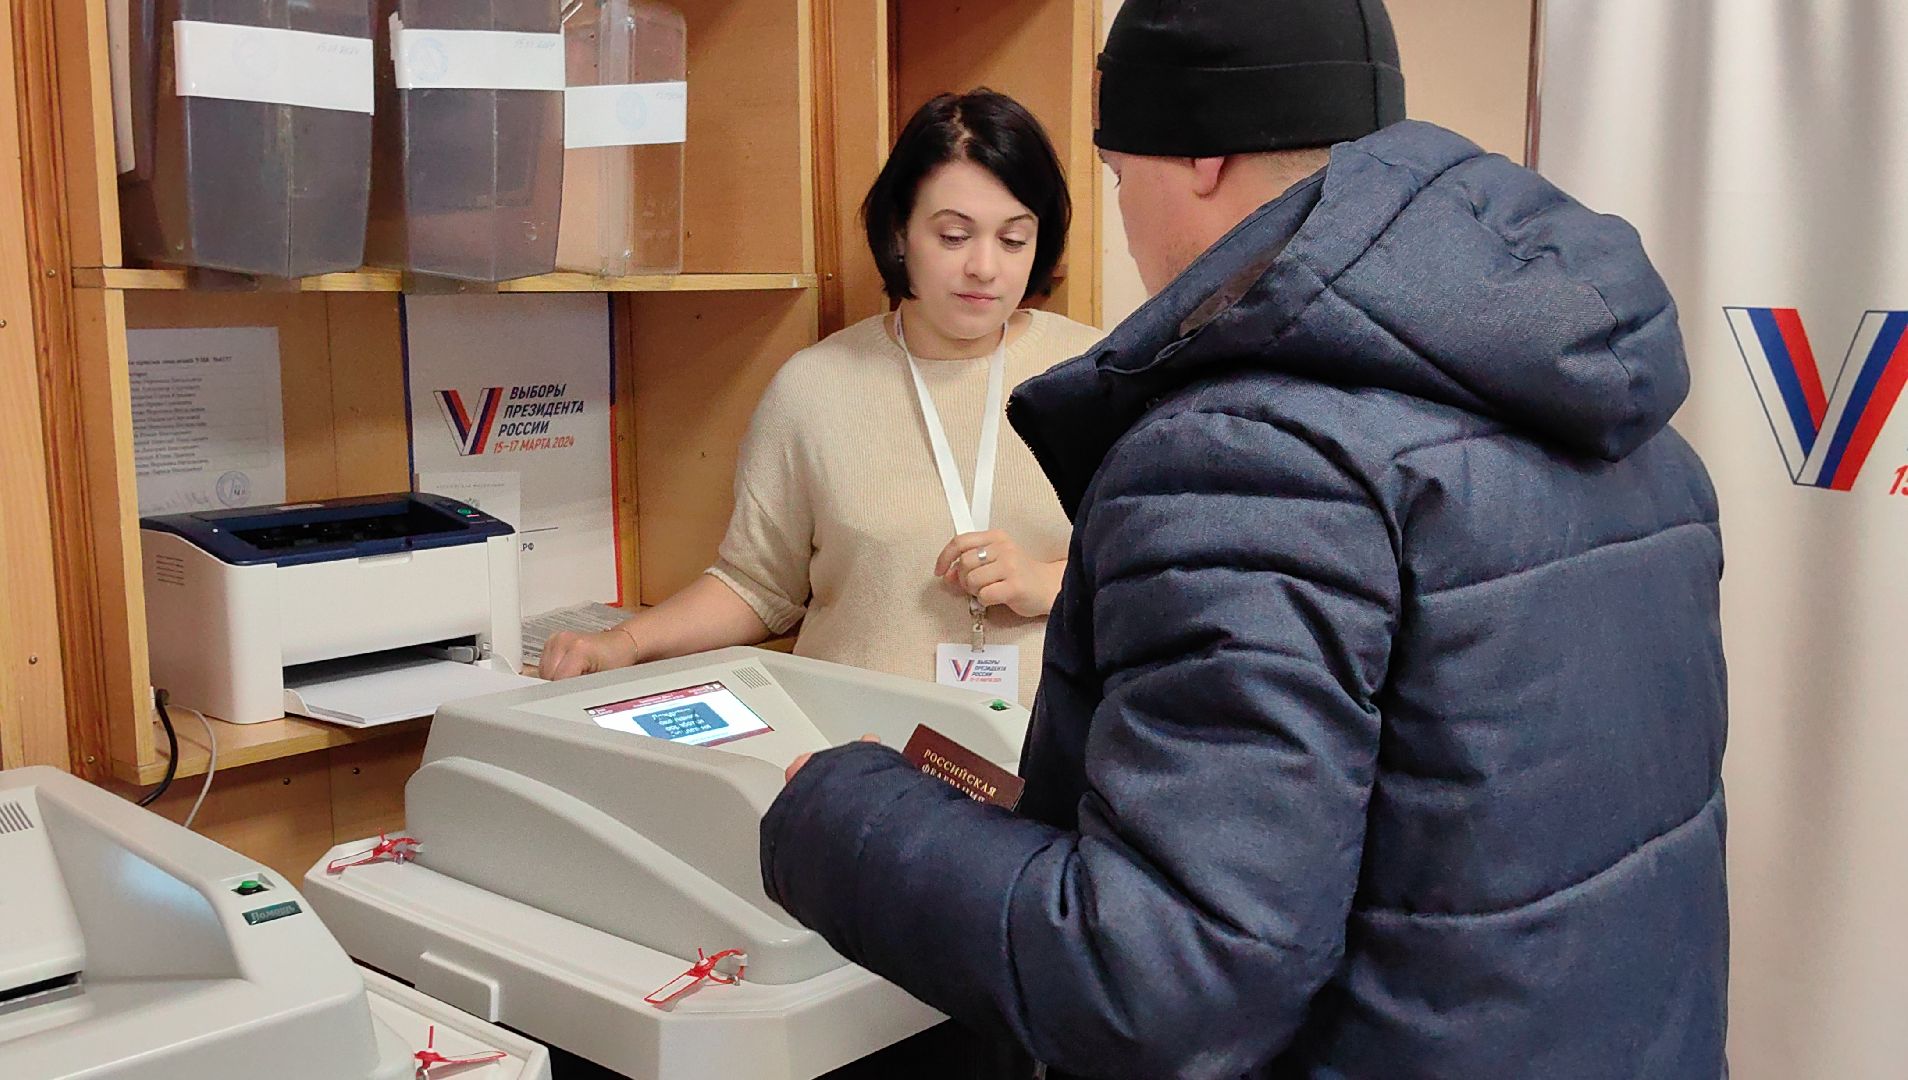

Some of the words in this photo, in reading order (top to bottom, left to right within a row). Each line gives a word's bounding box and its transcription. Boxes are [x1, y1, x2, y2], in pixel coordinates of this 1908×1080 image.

[509, 383, 567, 400] ВЫБОРЫ
[503, 401, 585, 419] ПРЕЗИДЕНТА
[498, 420, 550, 437] РОССИИ
[519, 437, 551, 451] МАРТА
[552, 434, 575, 449] 2024
[922, 748, 997, 797] РОССИЙСКАЯ
